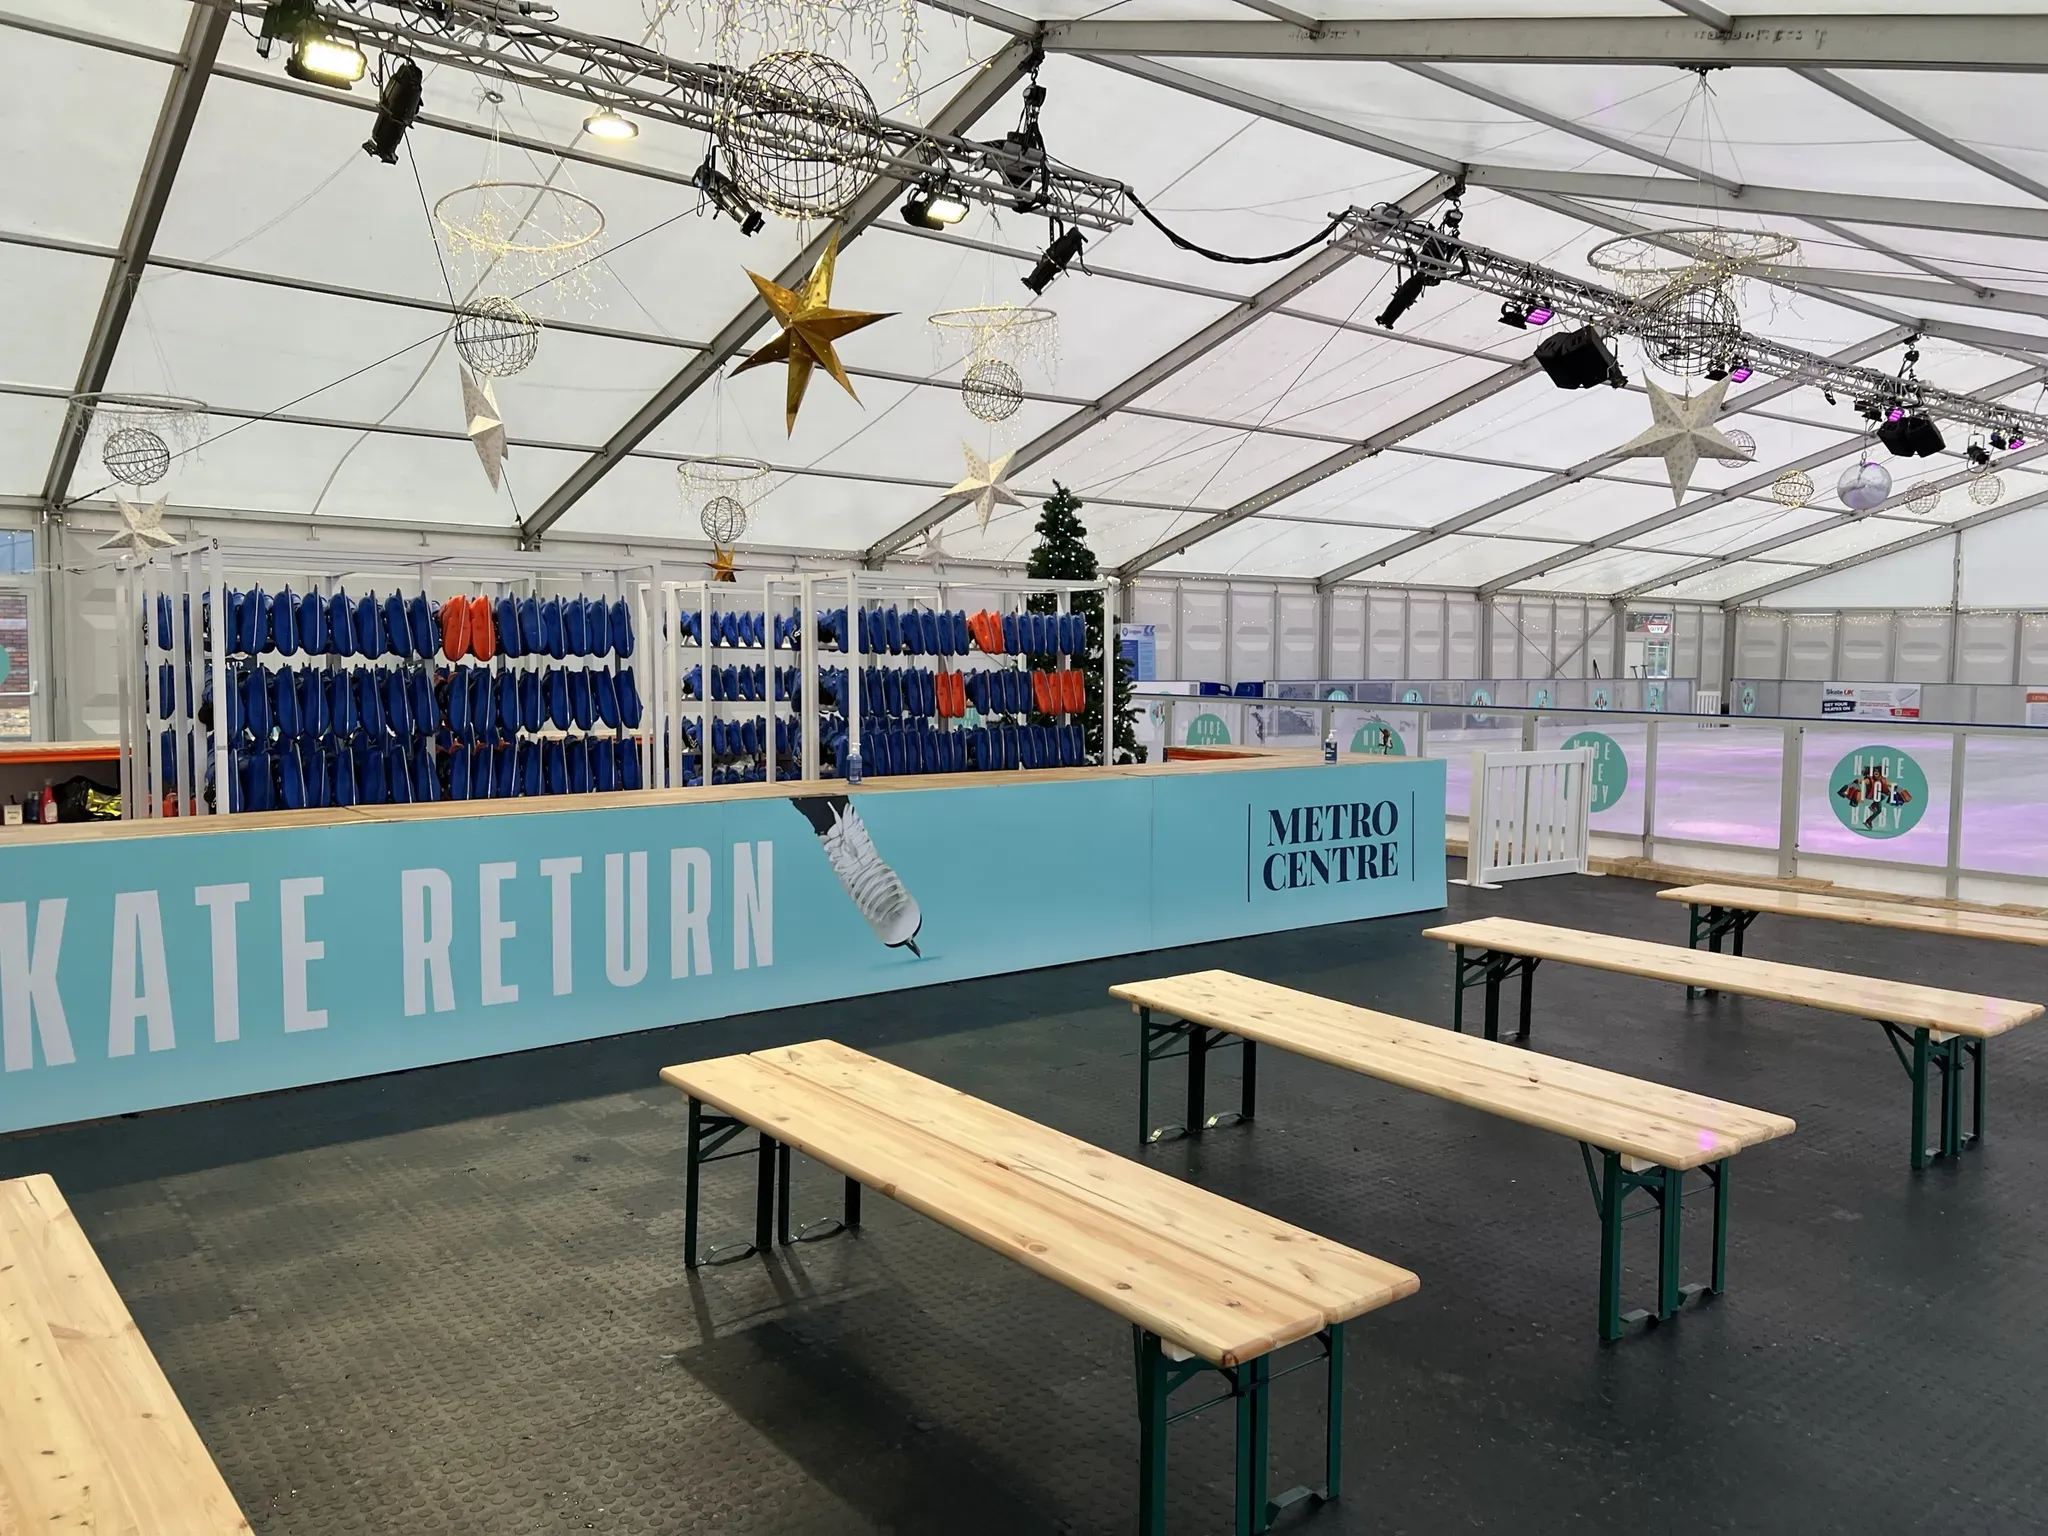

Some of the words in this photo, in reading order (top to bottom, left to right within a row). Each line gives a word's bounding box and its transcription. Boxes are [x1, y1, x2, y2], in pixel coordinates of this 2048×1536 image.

[1853, 755, 1905, 779] NICE
[1860, 780, 1898, 804] ICE
[1267, 800, 1398, 846] METRO
[1263, 842, 1398, 891] CENTRE
[0, 876, 328, 1072] KATE
[401, 840, 773, 1017] RETURN
